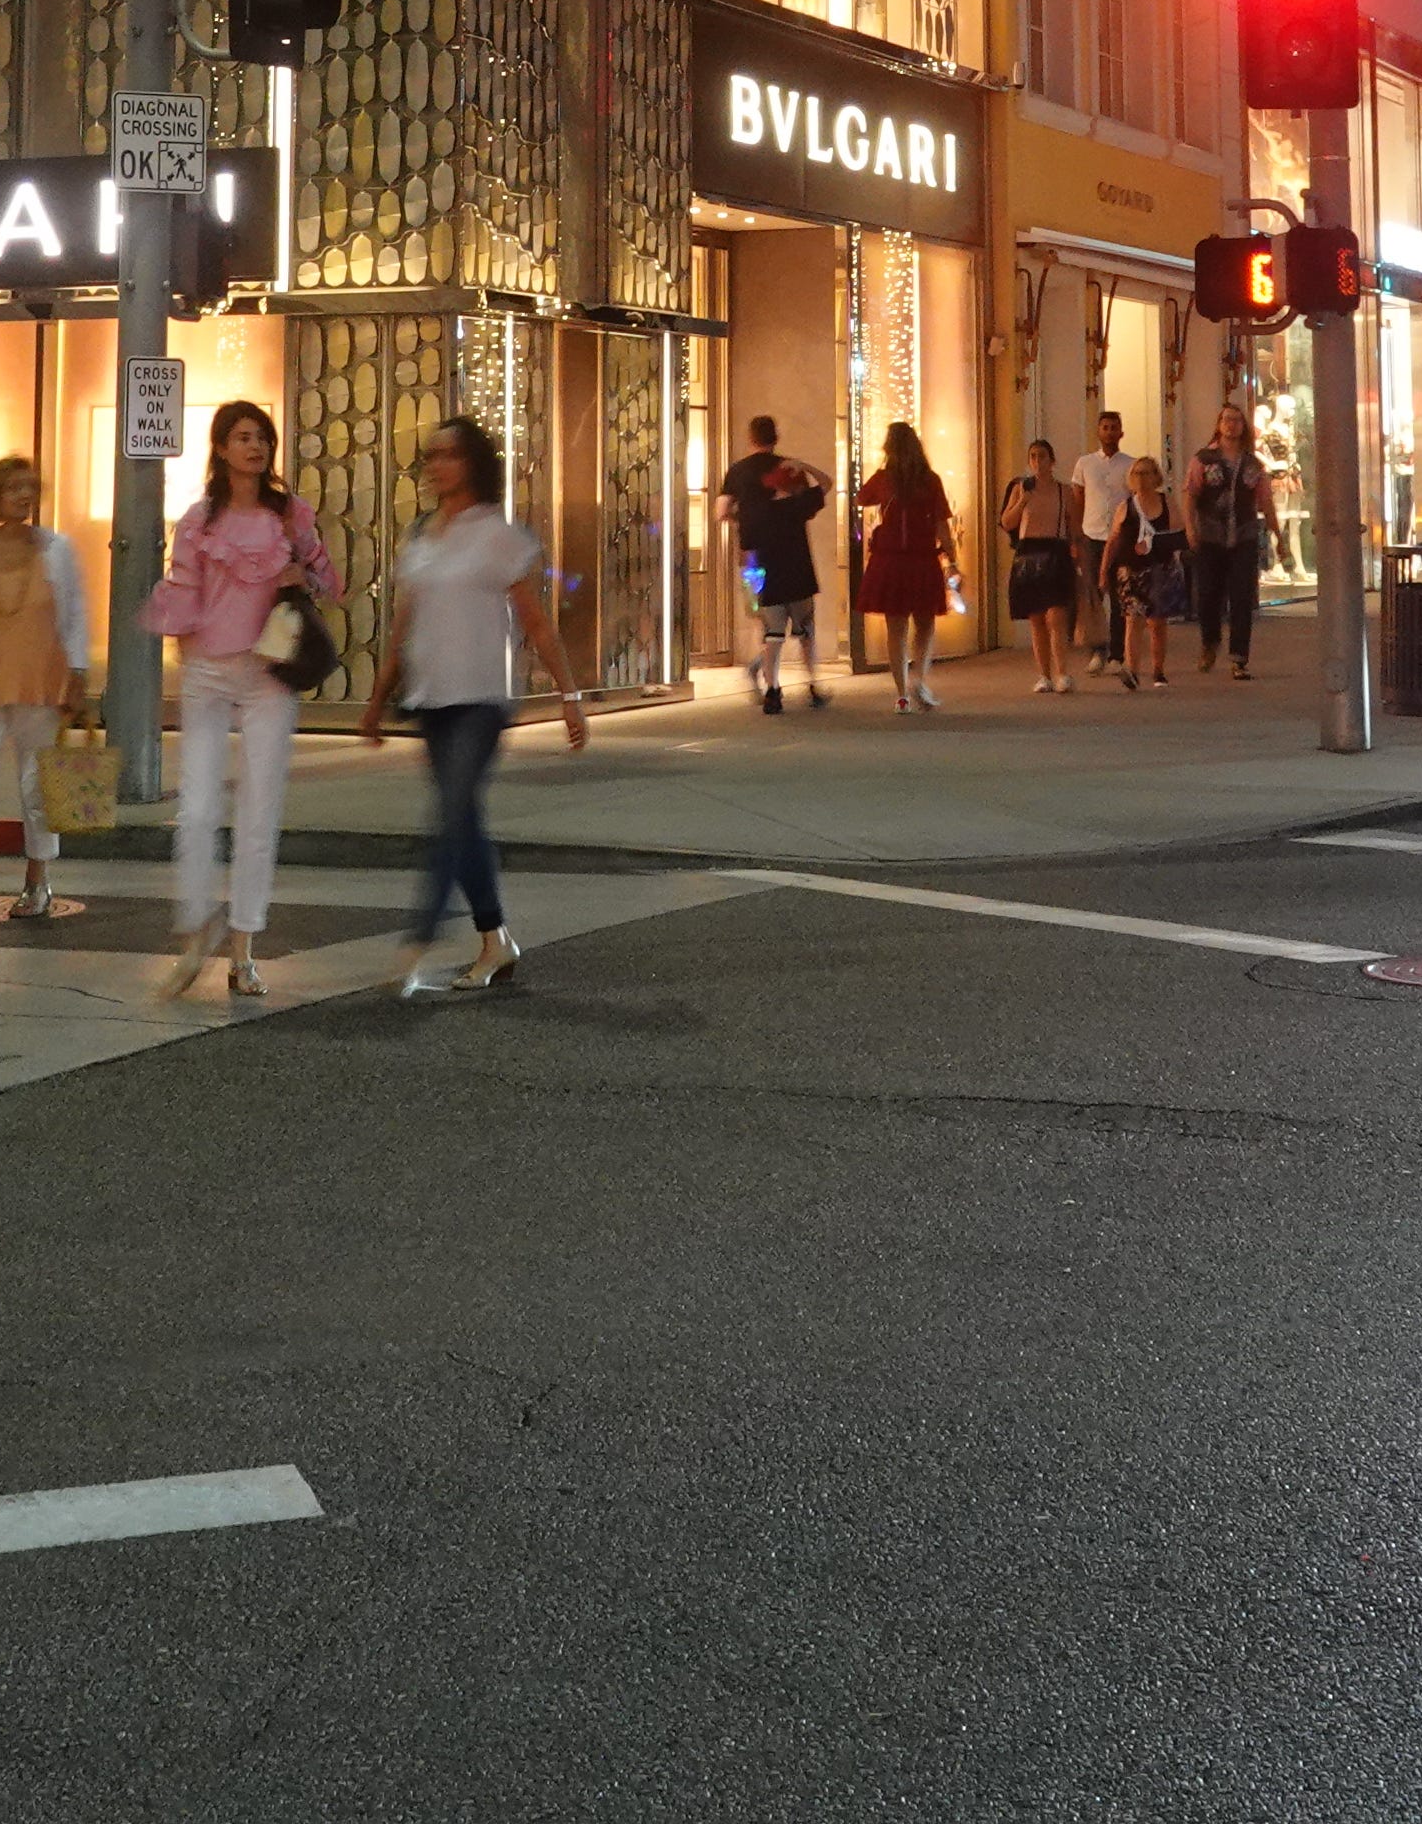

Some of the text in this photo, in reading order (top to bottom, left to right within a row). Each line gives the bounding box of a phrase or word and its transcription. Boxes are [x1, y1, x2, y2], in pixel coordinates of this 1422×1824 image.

[121, 100, 198, 118] DIAGONAL
[121, 119, 197, 137] CROSSING
[730, 74, 957, 192] BVLGARI
[120, 149, 154, 180] OK
[1250, 253, 1274, 305] 6
[134, 366, 178, 380] CROSS
[139, 384, 172, 397] ONLY
[146, 401, 164, 414] ON
[137, 418, 172, 431] WALK
[131, 435, 178, 449] SIGNAL
